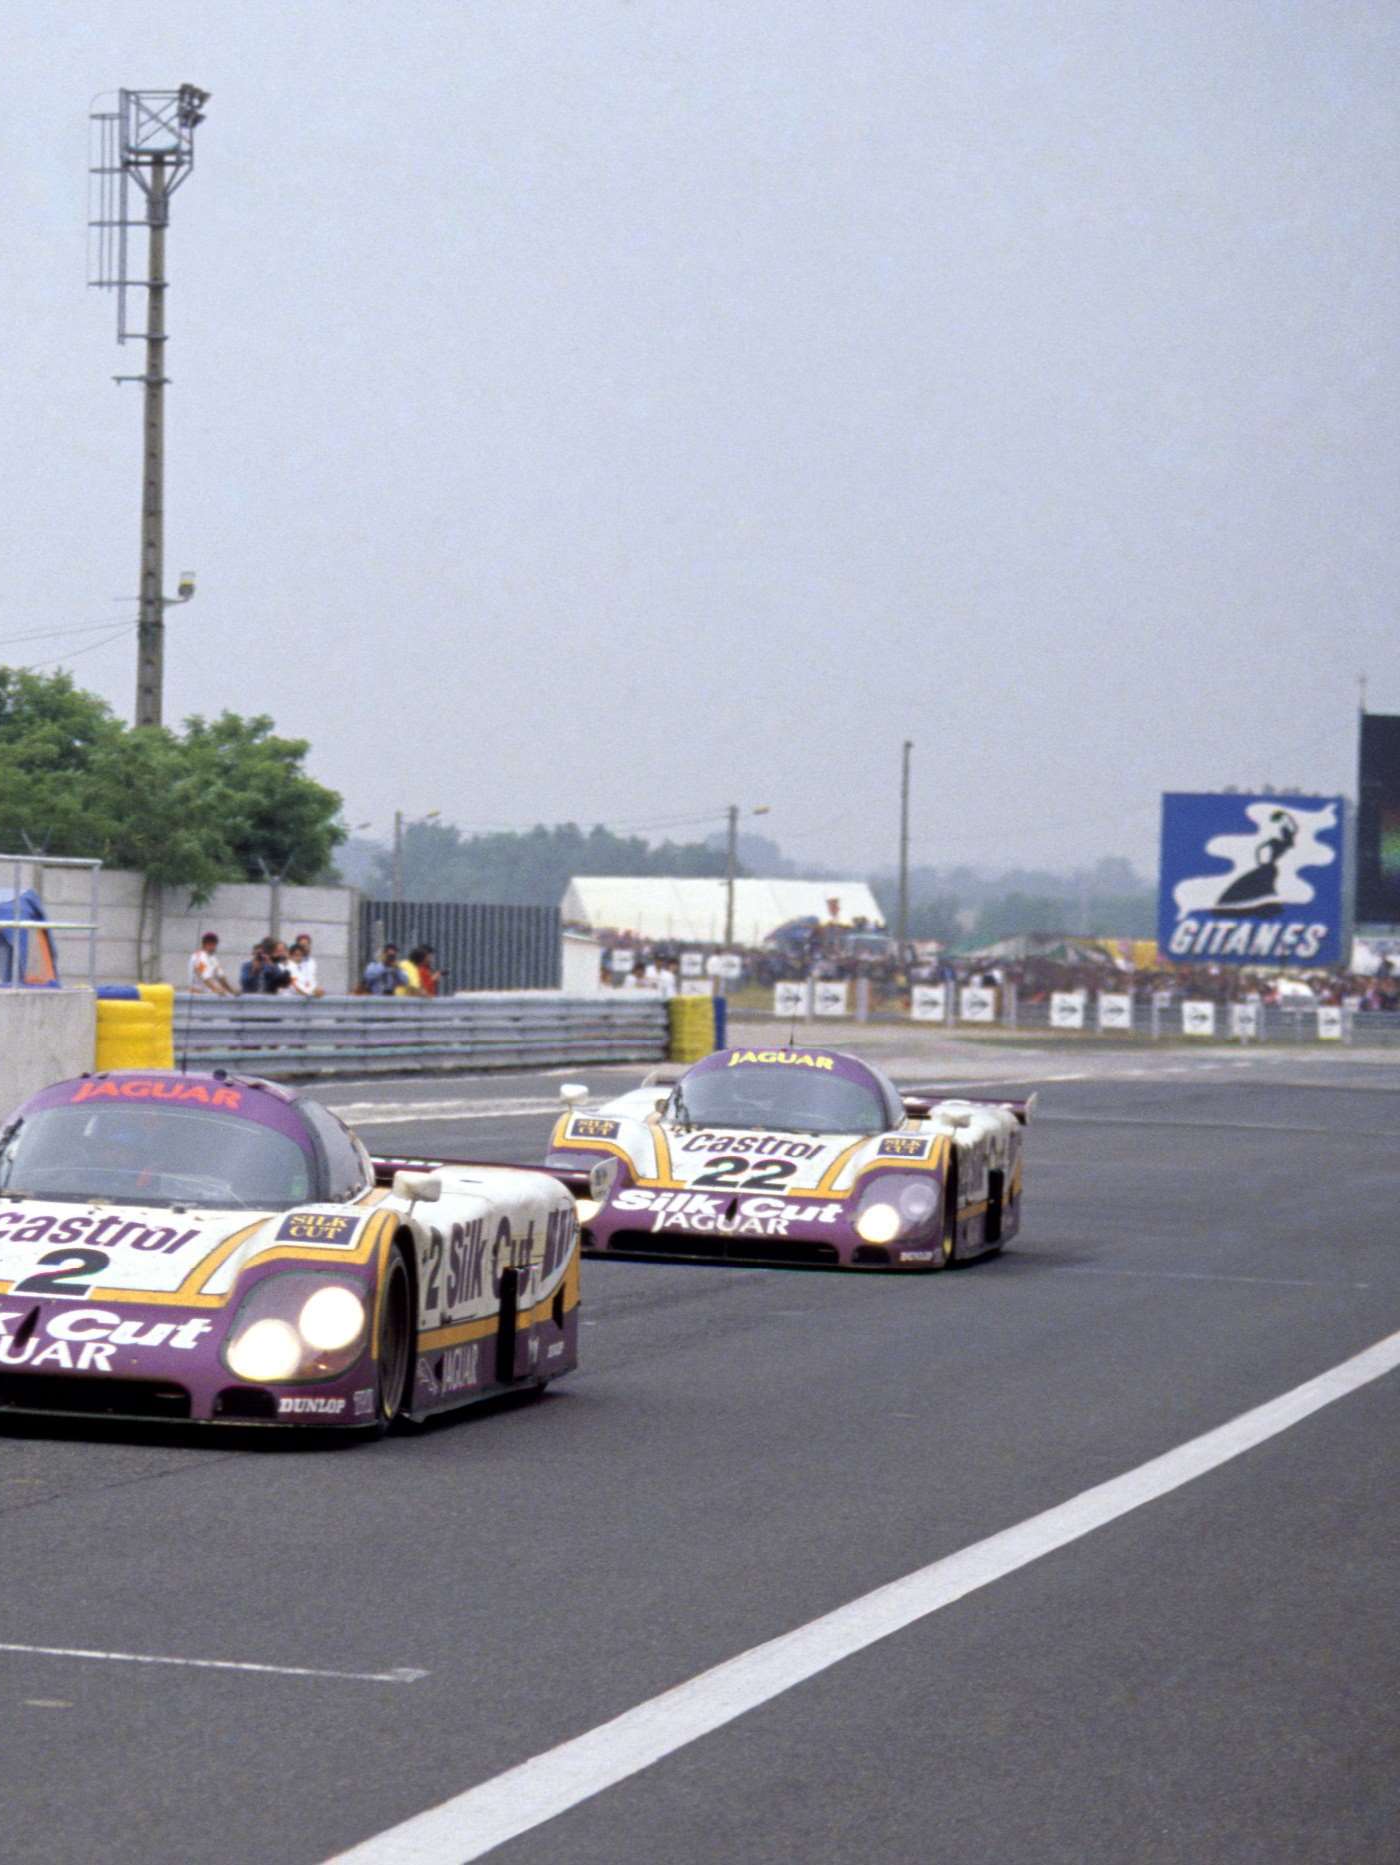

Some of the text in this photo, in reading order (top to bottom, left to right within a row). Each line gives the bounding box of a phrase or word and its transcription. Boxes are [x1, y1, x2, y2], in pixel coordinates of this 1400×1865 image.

[1168, 920, 1328, 958] GITANES
[728, 1051, 834, 1070] JAGUAR
[71, 1080, 241, 1110] JAGUAR
[682, 1134, 826, 1160] Castrol
[692, 1156, 798, 1191] 22
[611, 1189, 843, 1223] Silk Cut
[289, 1225, 342, 1239] CUT
[290, 1215, 348, 1228] SILK
[651, 1211, 790, 1236] JAGUAR
[14, 1248, 110, 1296] 2
[446, 1217, 488, 1310] Silk
[46, 1308, 212, 1349] Cut
[278, 1397, 346, 1414] DUNLOP
